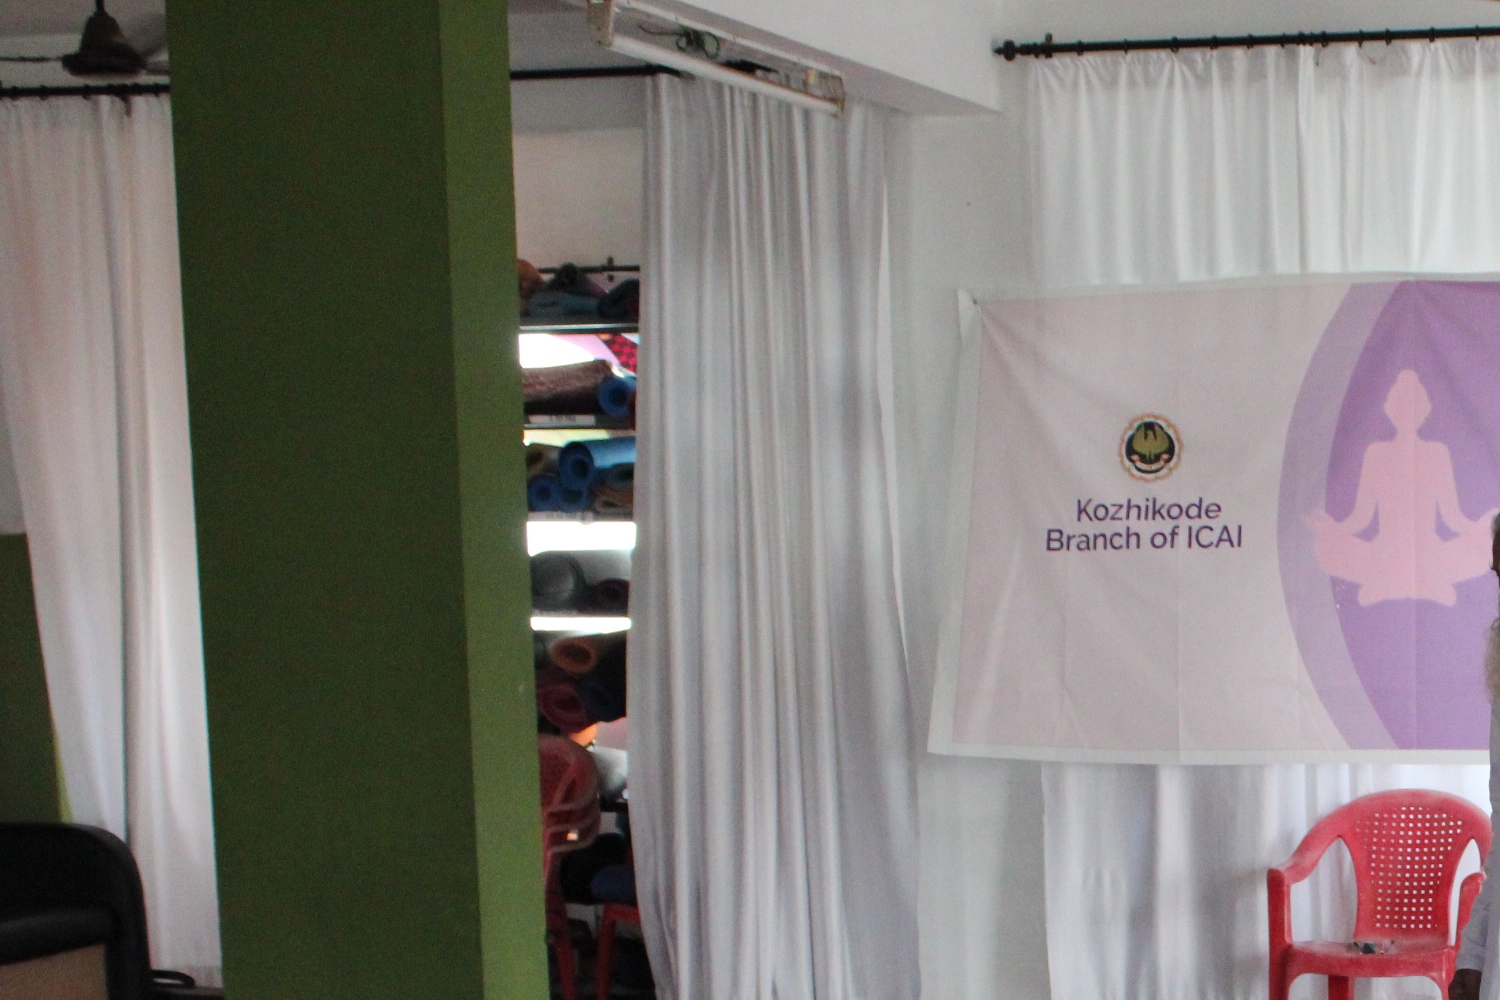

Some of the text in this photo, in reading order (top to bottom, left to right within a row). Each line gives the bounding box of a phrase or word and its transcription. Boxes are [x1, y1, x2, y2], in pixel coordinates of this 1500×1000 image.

[1077, 497, 1222, 522] Kozhikode
[1046, 525, 1242, 551] Branch of ICAI
